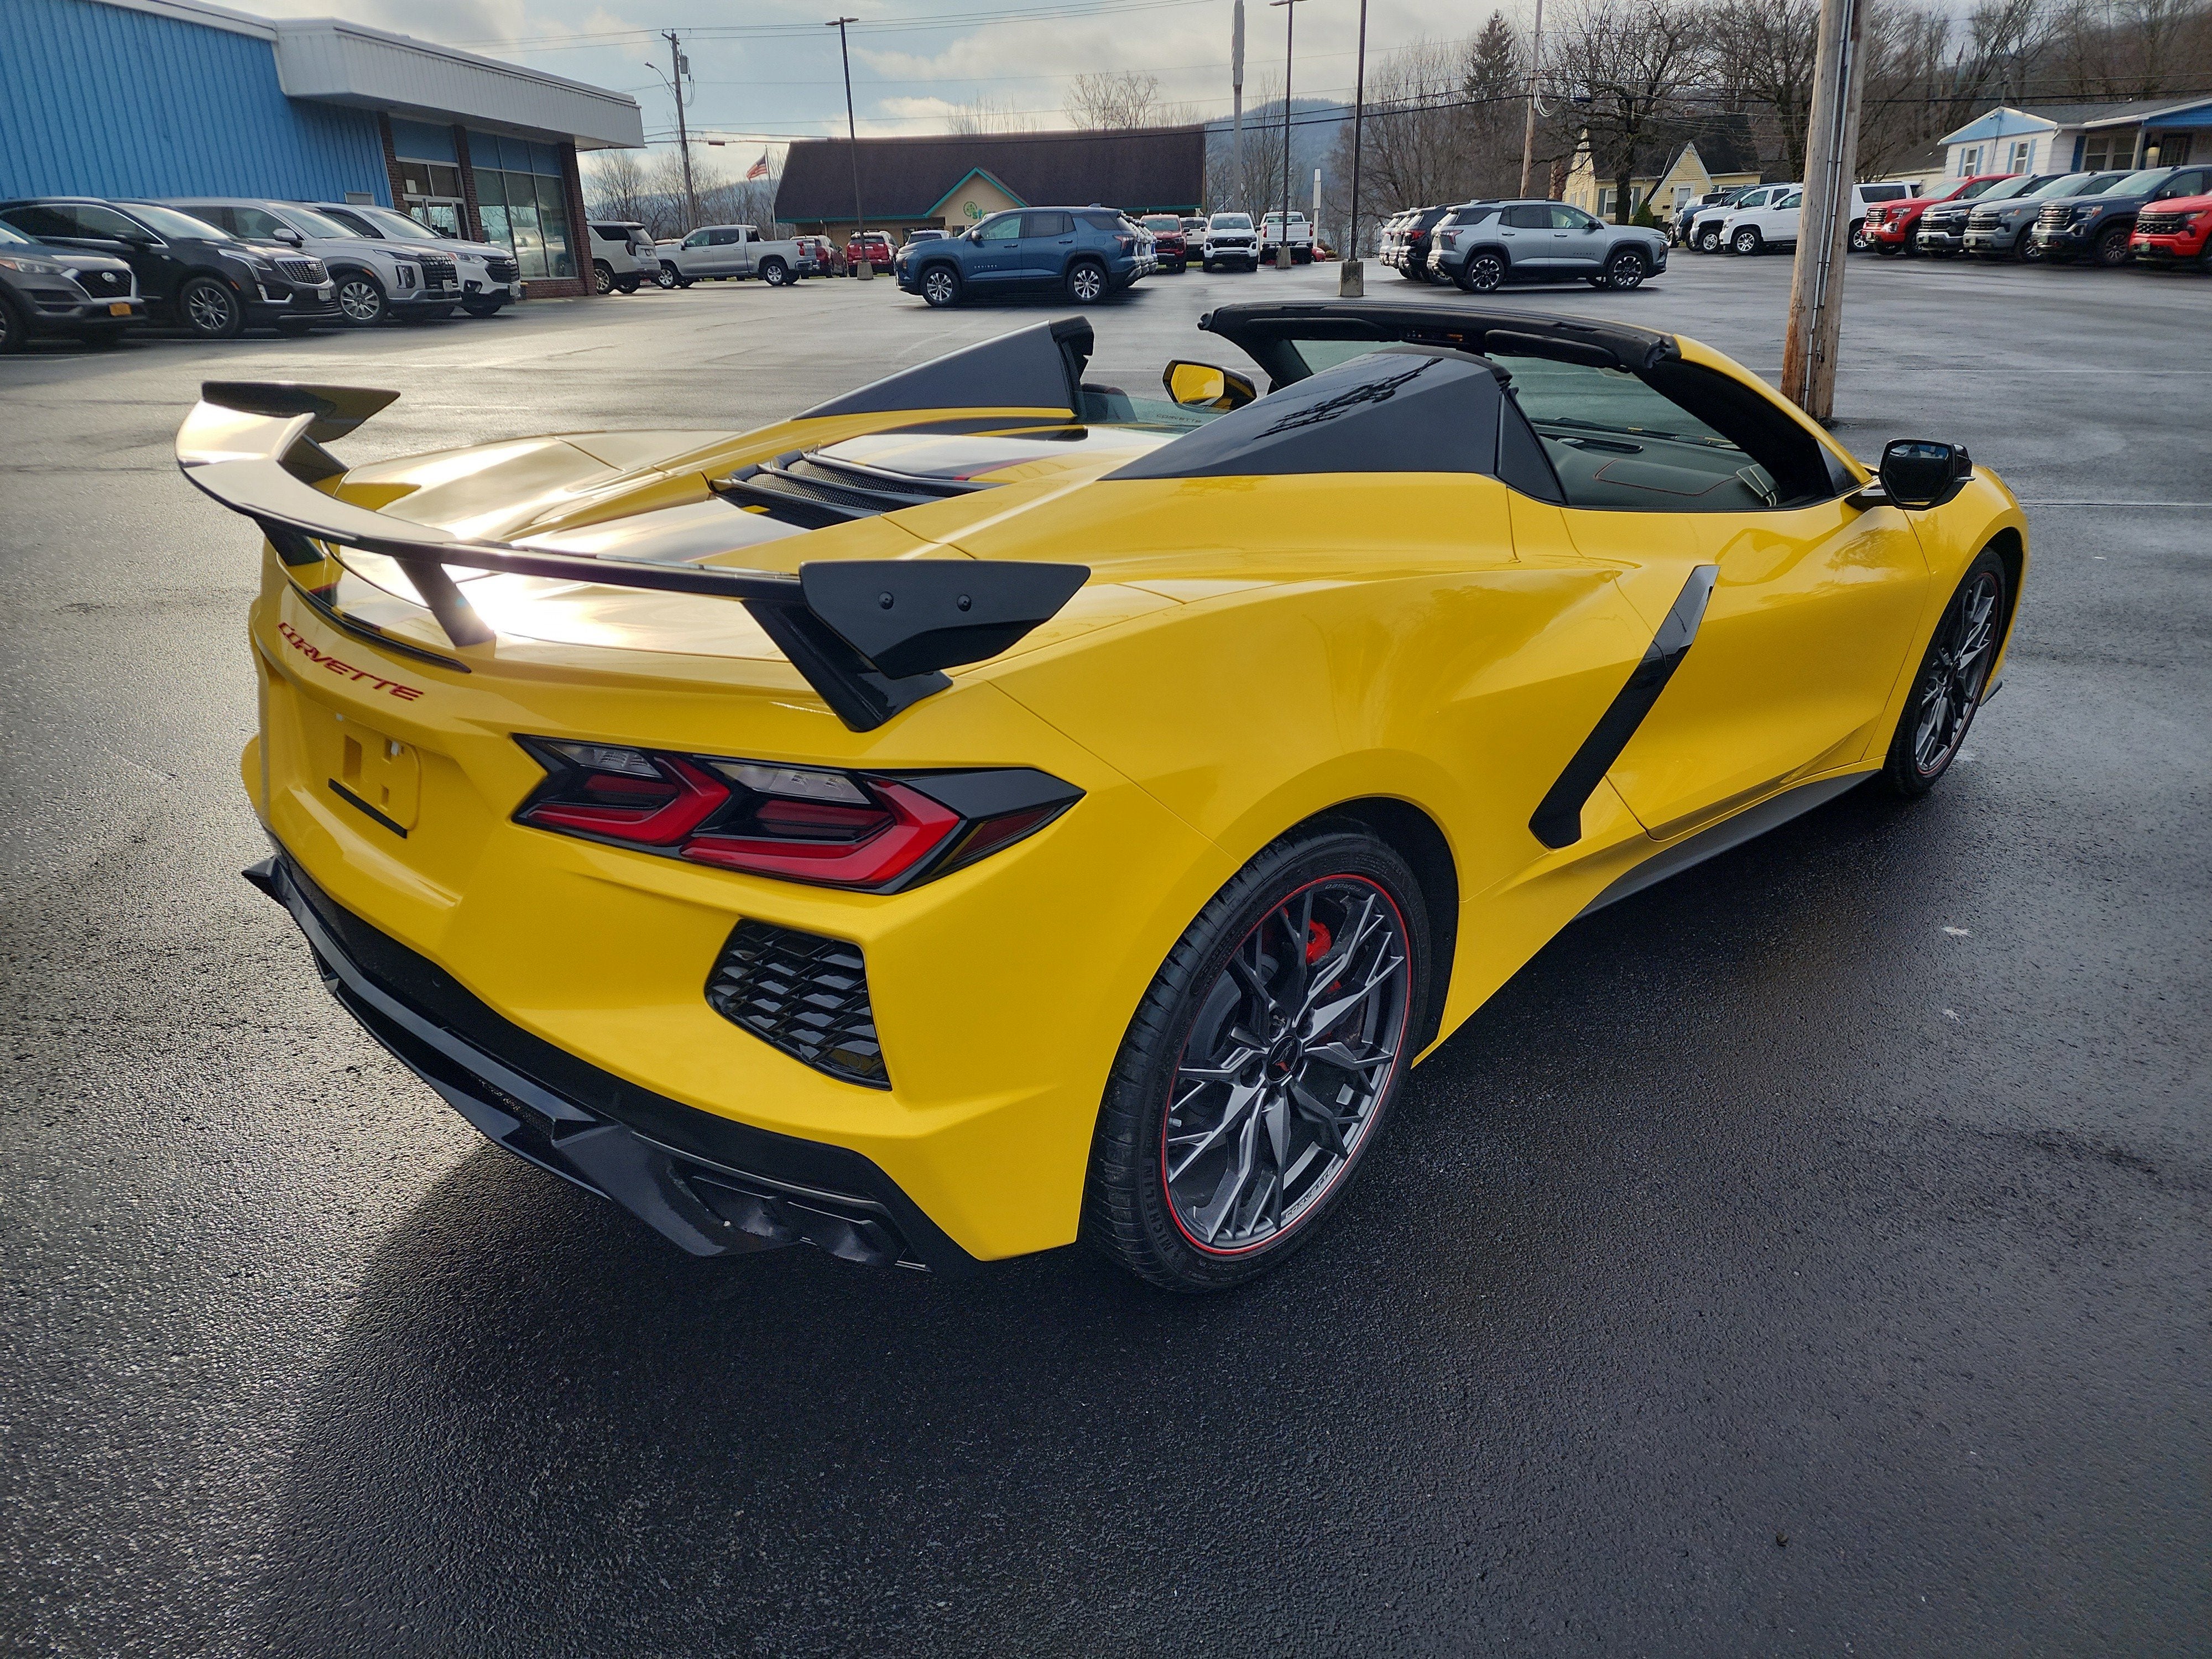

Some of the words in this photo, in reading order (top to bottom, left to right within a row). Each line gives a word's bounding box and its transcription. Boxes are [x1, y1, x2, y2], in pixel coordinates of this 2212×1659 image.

[277, 622, 424, 701] CORVETTE
[1325, 883, 1362, 892] FORGED
[1143, 1164, 1175, 1252] MICHELIN
[1285, 1165, 1334, 1218] CORVETTE
